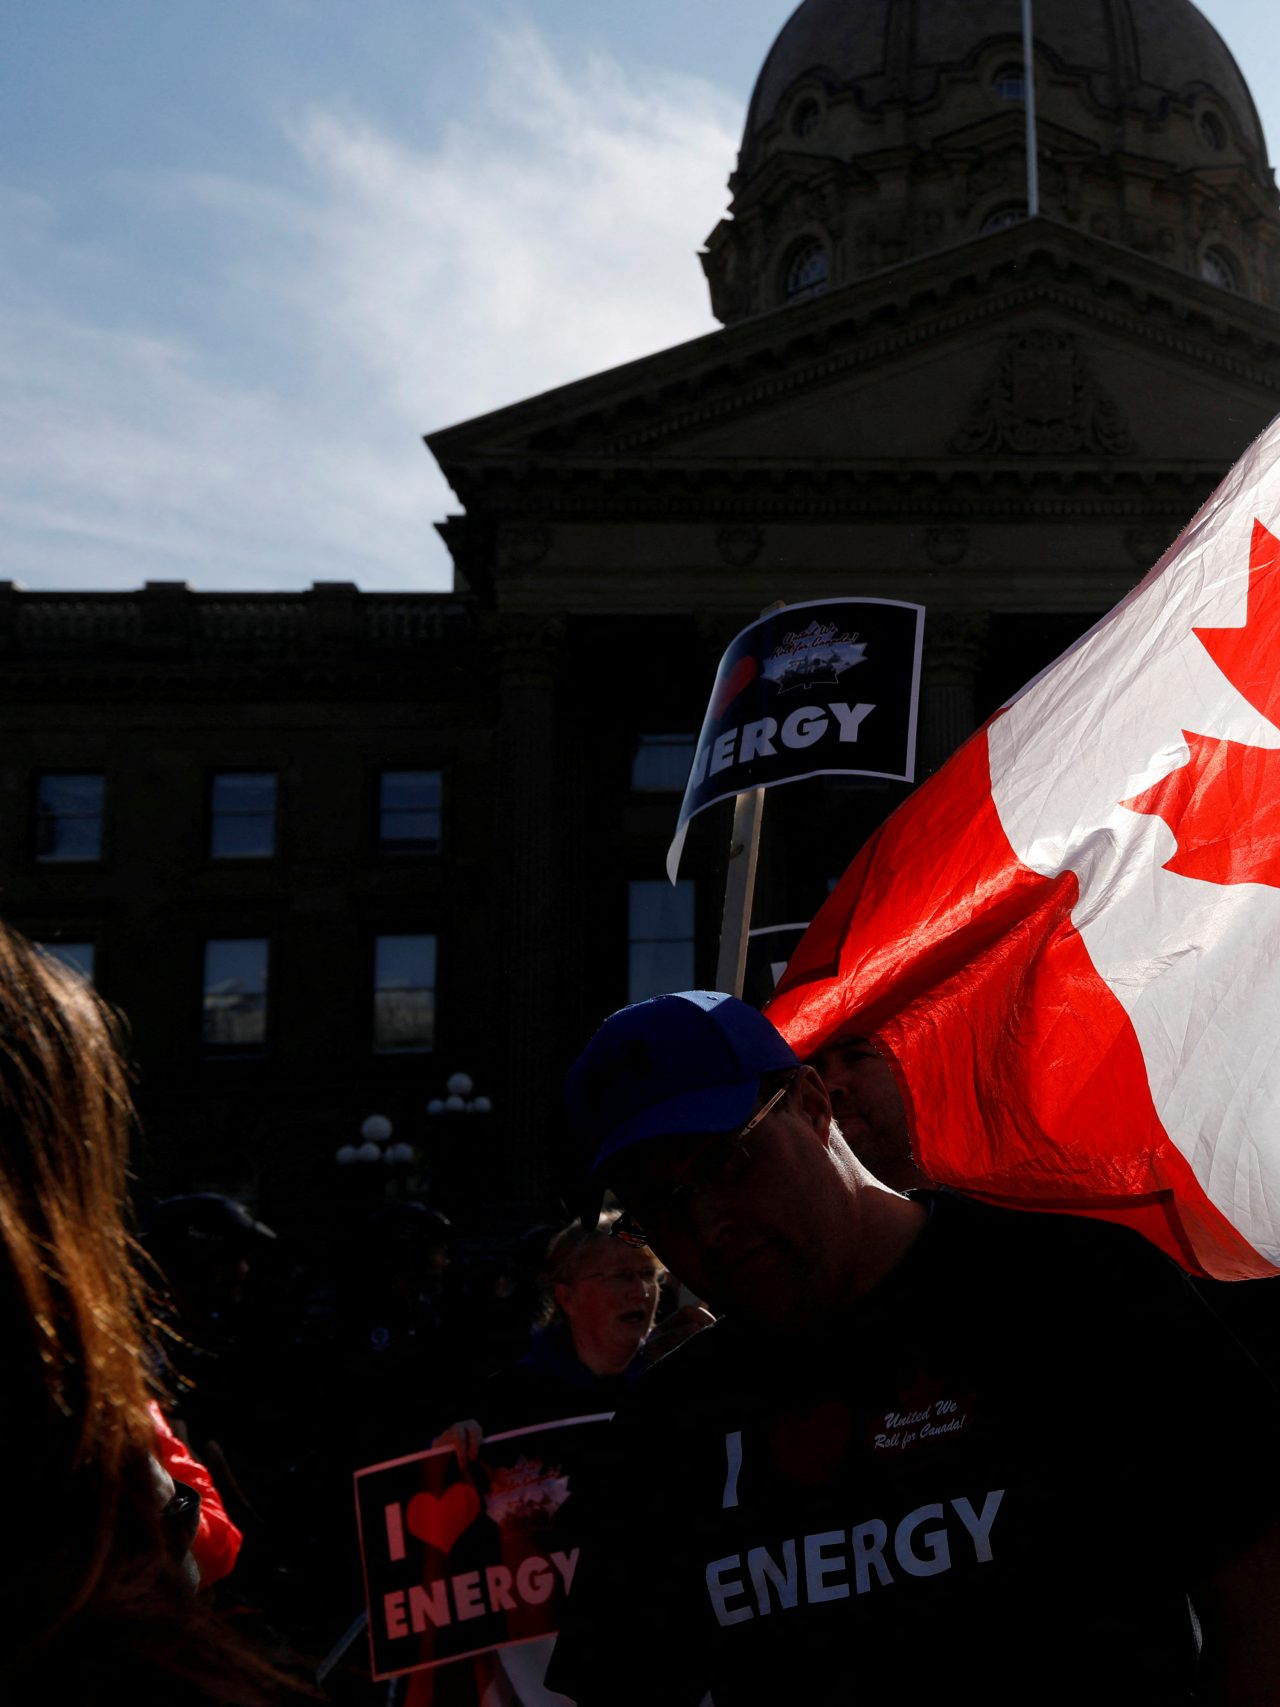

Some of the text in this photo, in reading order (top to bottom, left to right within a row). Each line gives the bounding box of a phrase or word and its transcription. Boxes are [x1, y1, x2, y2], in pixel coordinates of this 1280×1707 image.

[874, 1413, 966, 1450] Roll for Canada!
[884, 1399, 959, 1430] United We
[721, 1430, 743, 1510] I
[384, 1501, 407, 1563] I
[705, 1489, 1006, 1628] ENERGY
[383, 1546, 581, 1641] ENERGY
